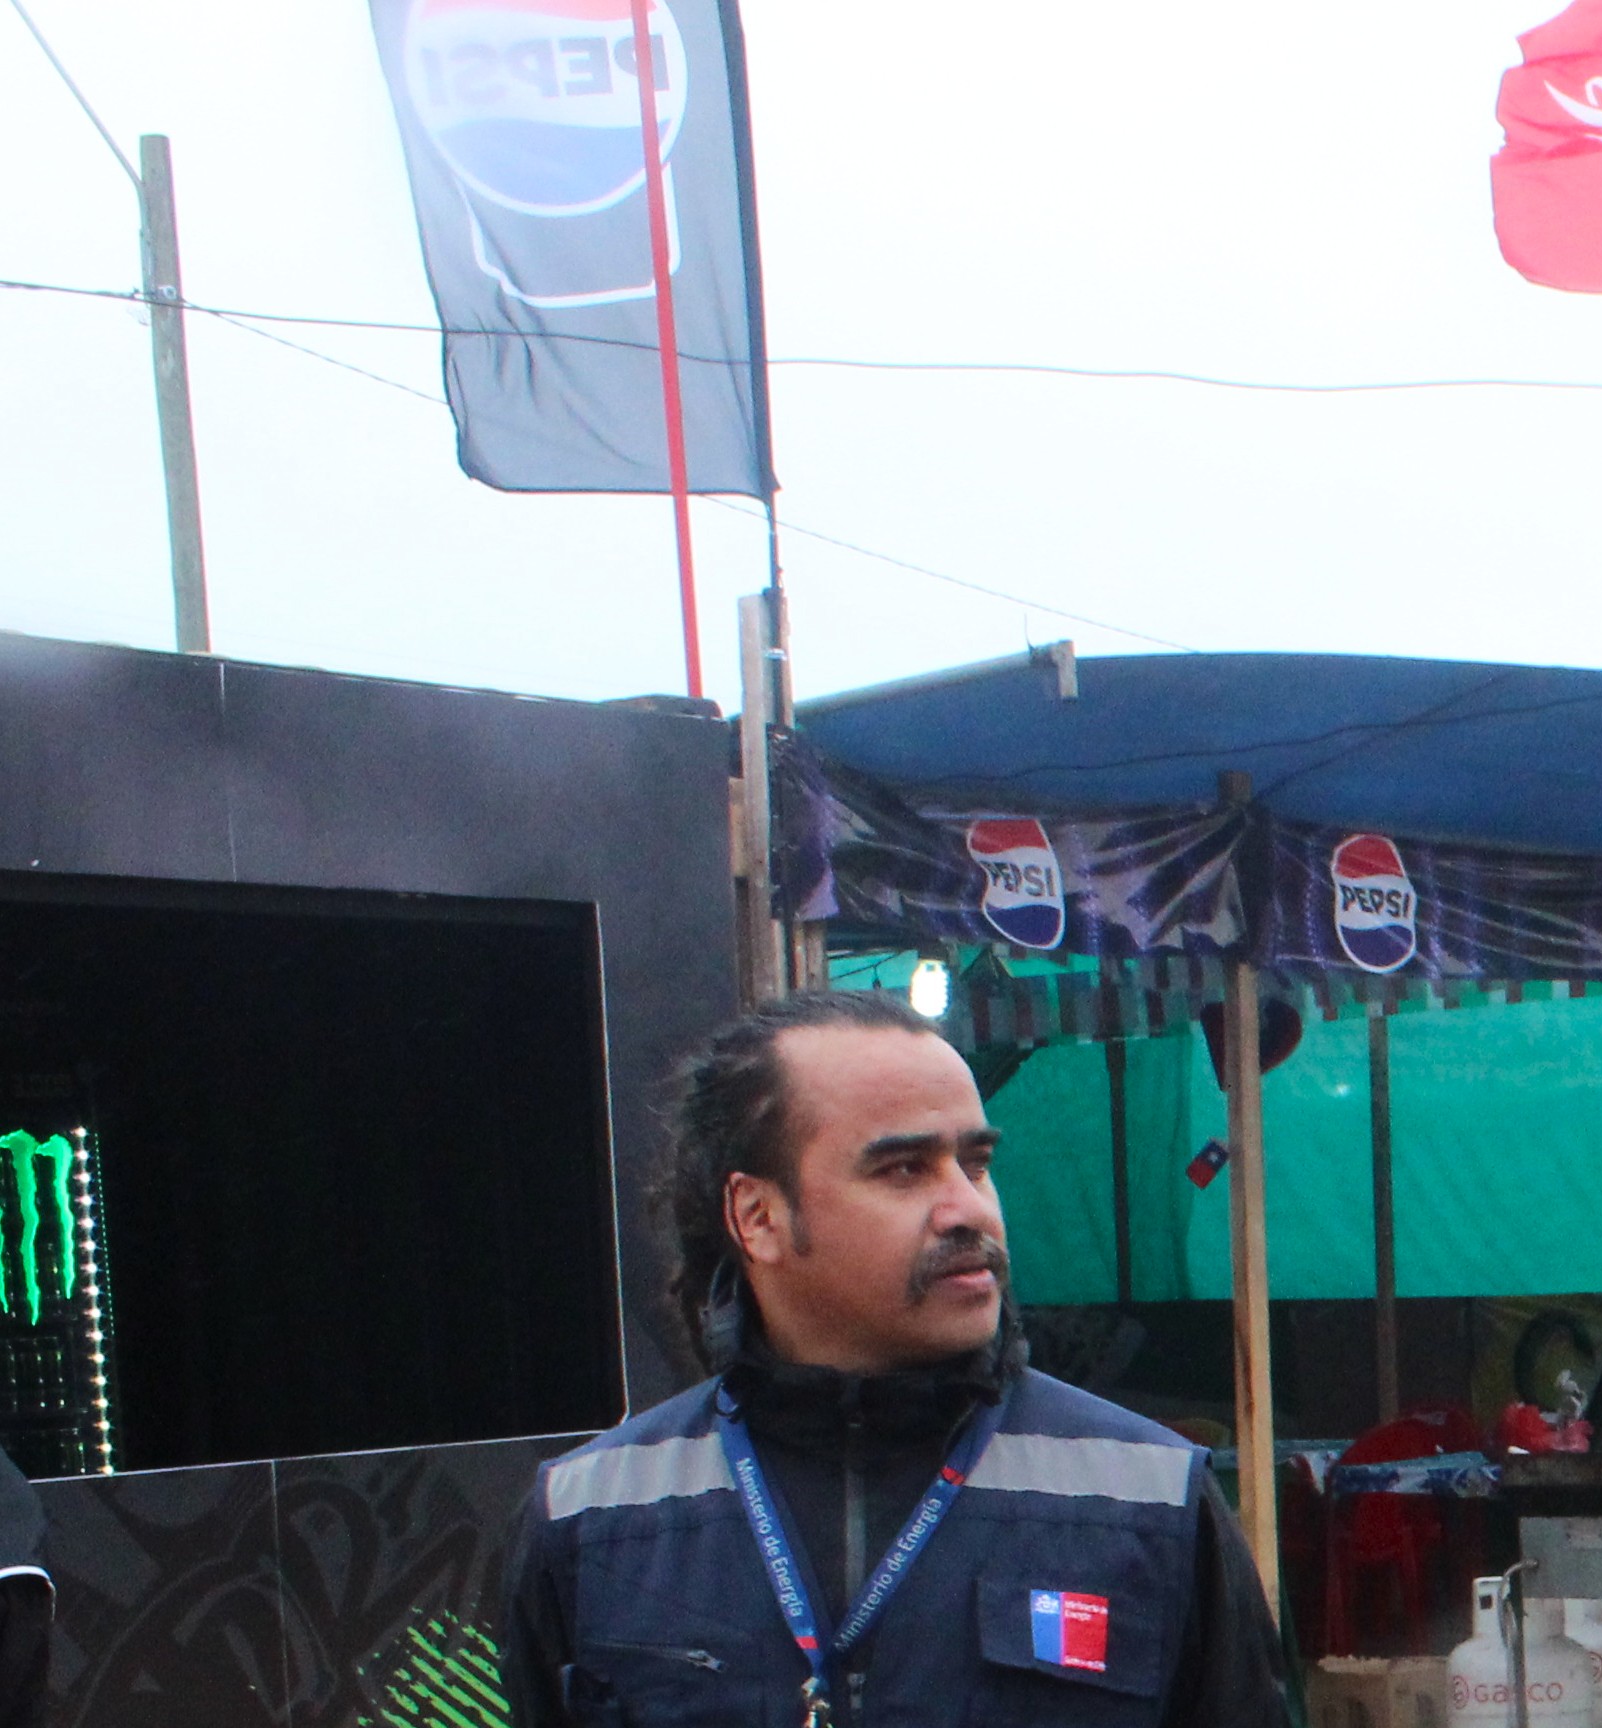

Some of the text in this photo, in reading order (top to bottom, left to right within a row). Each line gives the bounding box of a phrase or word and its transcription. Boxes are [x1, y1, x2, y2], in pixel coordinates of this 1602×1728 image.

[980, 859, 1057, 898] PEPSI
[1339, 883, 1411, 920] PEPSI
[736, 1457, 803, 1618] Ministerio de Energía
[832, 1498, 943, 1652] Ministerio de Energía
